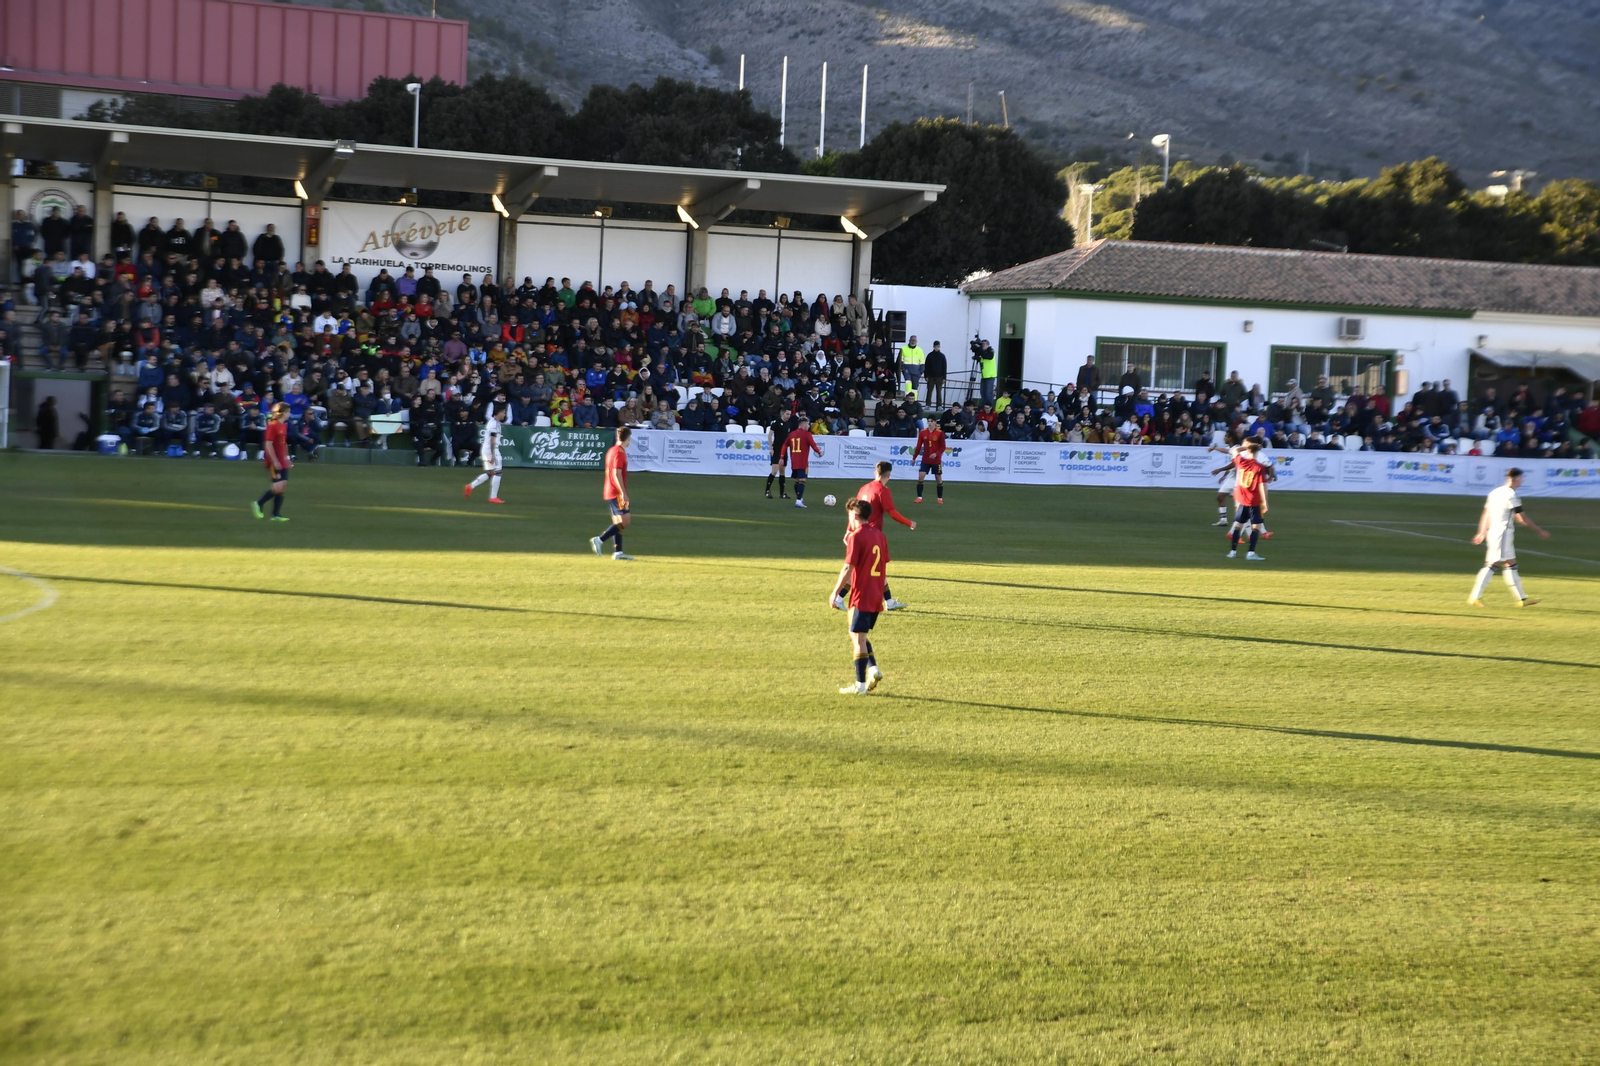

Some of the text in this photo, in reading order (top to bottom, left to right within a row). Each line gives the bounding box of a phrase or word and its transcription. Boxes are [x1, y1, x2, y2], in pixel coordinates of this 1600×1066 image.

[358, 216, 471, 253] Atrévete
[332, 256, 345, 264] LA
[348, 257, 405, 268] CARIHUELA
[415, 262, 492, 273] TORREMOLINOS
[568, 432, 600, 440] FRUTAS
[791, 437, 801, 452] 11
[530, 446, 604, 461] Manantiales
[1059, 464, 1129, 472] TORREMOLINOS
[870, 545, 881, 577] 2
